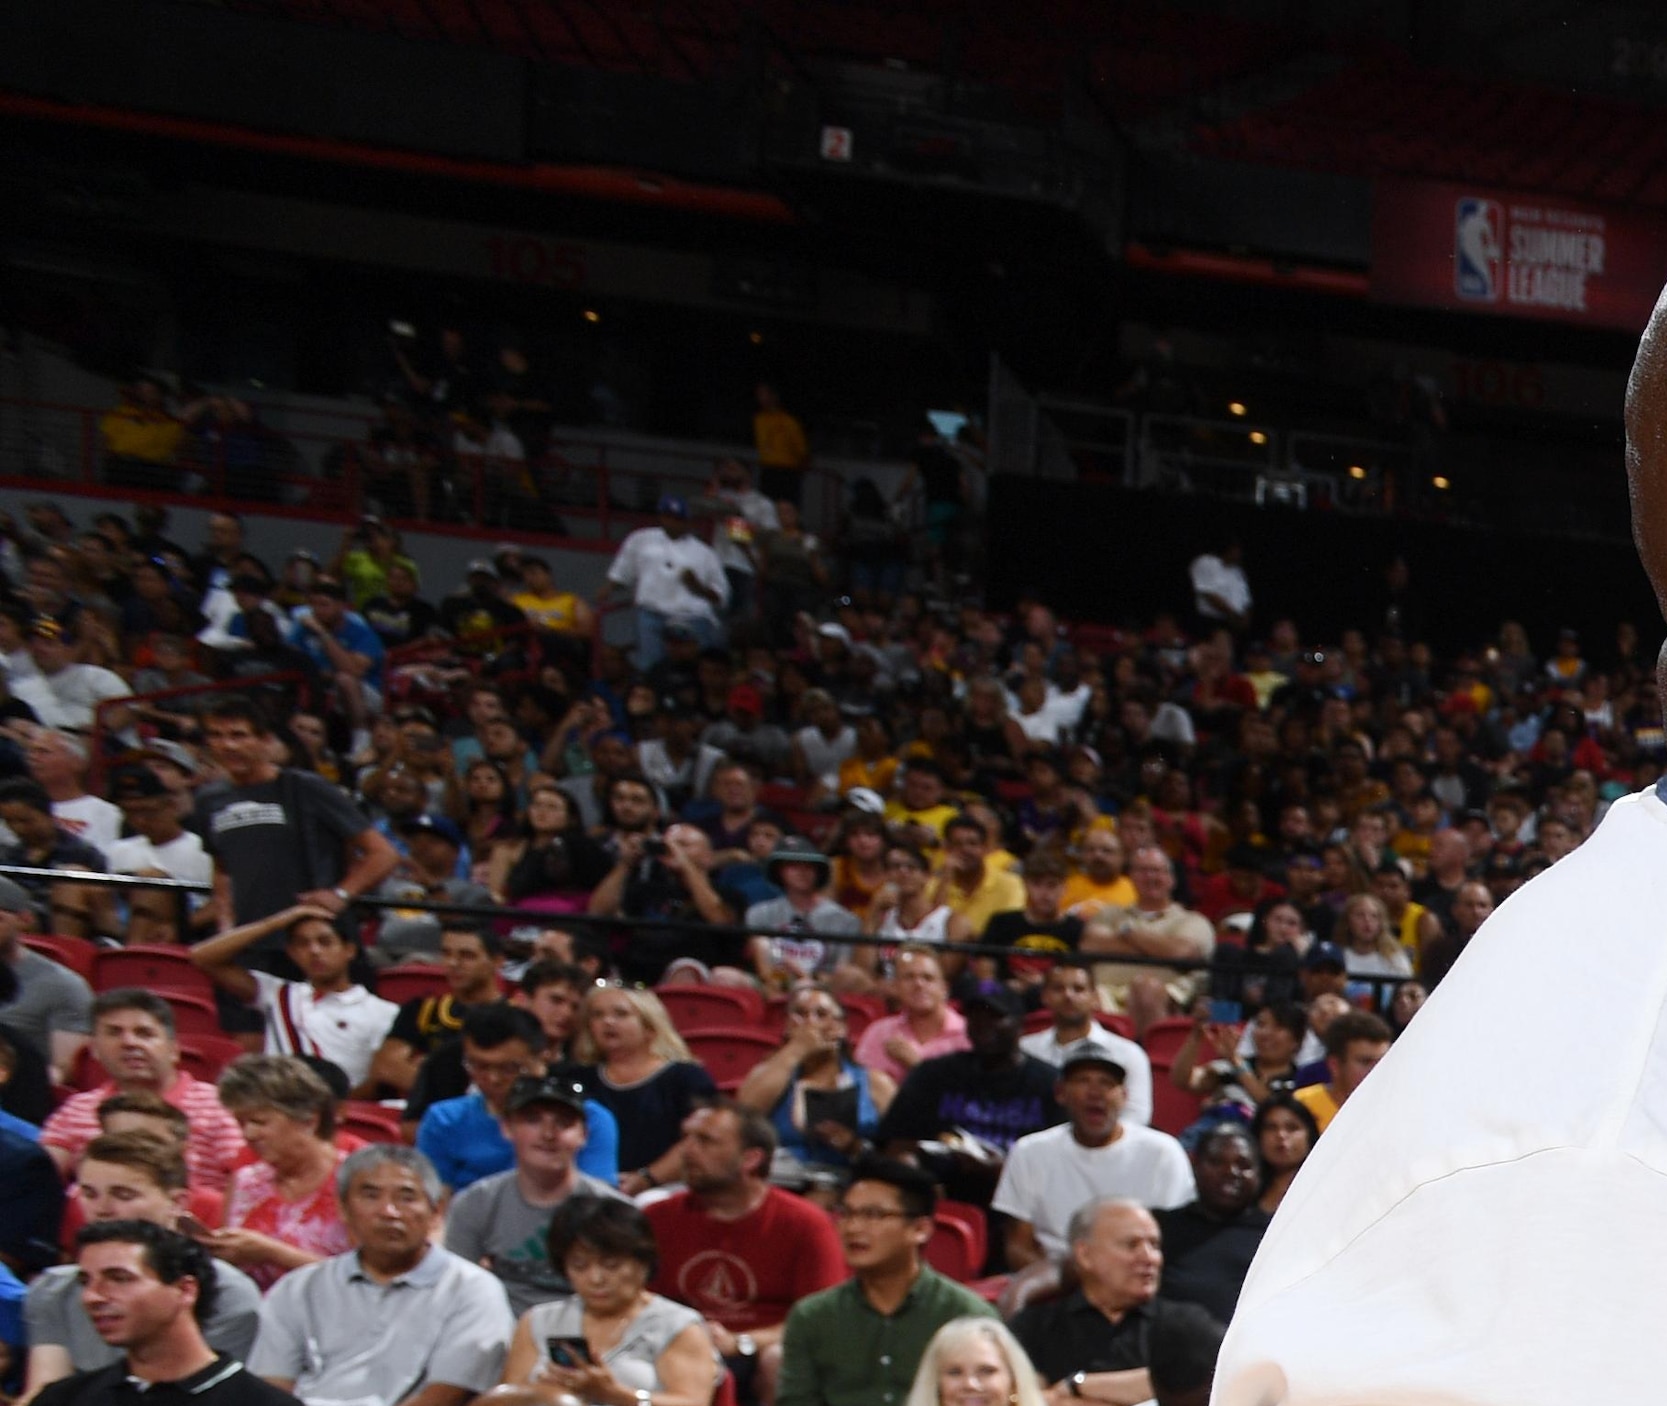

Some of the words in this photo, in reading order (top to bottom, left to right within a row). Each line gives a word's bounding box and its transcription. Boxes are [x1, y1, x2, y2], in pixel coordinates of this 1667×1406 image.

[484, 234, 587, 287] 105
[1510, 226, 1605, 275] SUMMER
[1508, 263, 1586, 312] LEAGUE
[1451, 360, 1547, 409] 106
